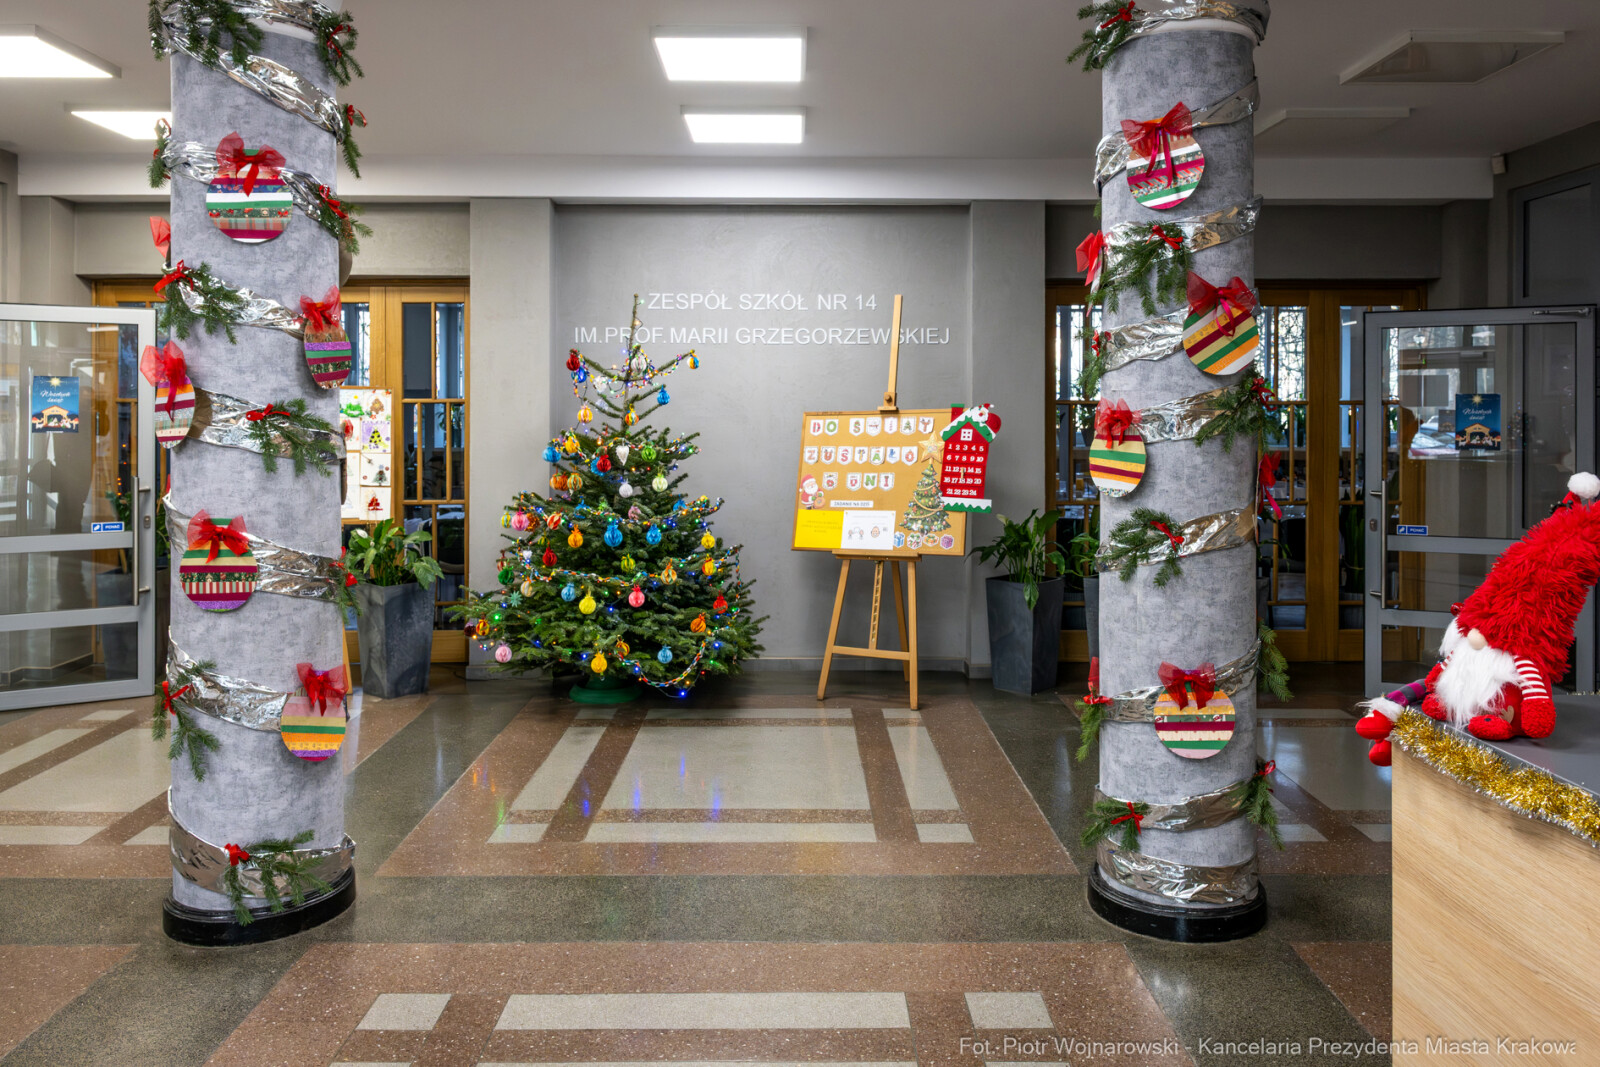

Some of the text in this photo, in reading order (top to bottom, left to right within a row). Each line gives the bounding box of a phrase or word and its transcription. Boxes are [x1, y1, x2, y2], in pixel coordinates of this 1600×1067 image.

[647, 290, 878, 311] ZESPÓŁ SZKÓŁ NR 14
[812, 420, 837, 433] DO
